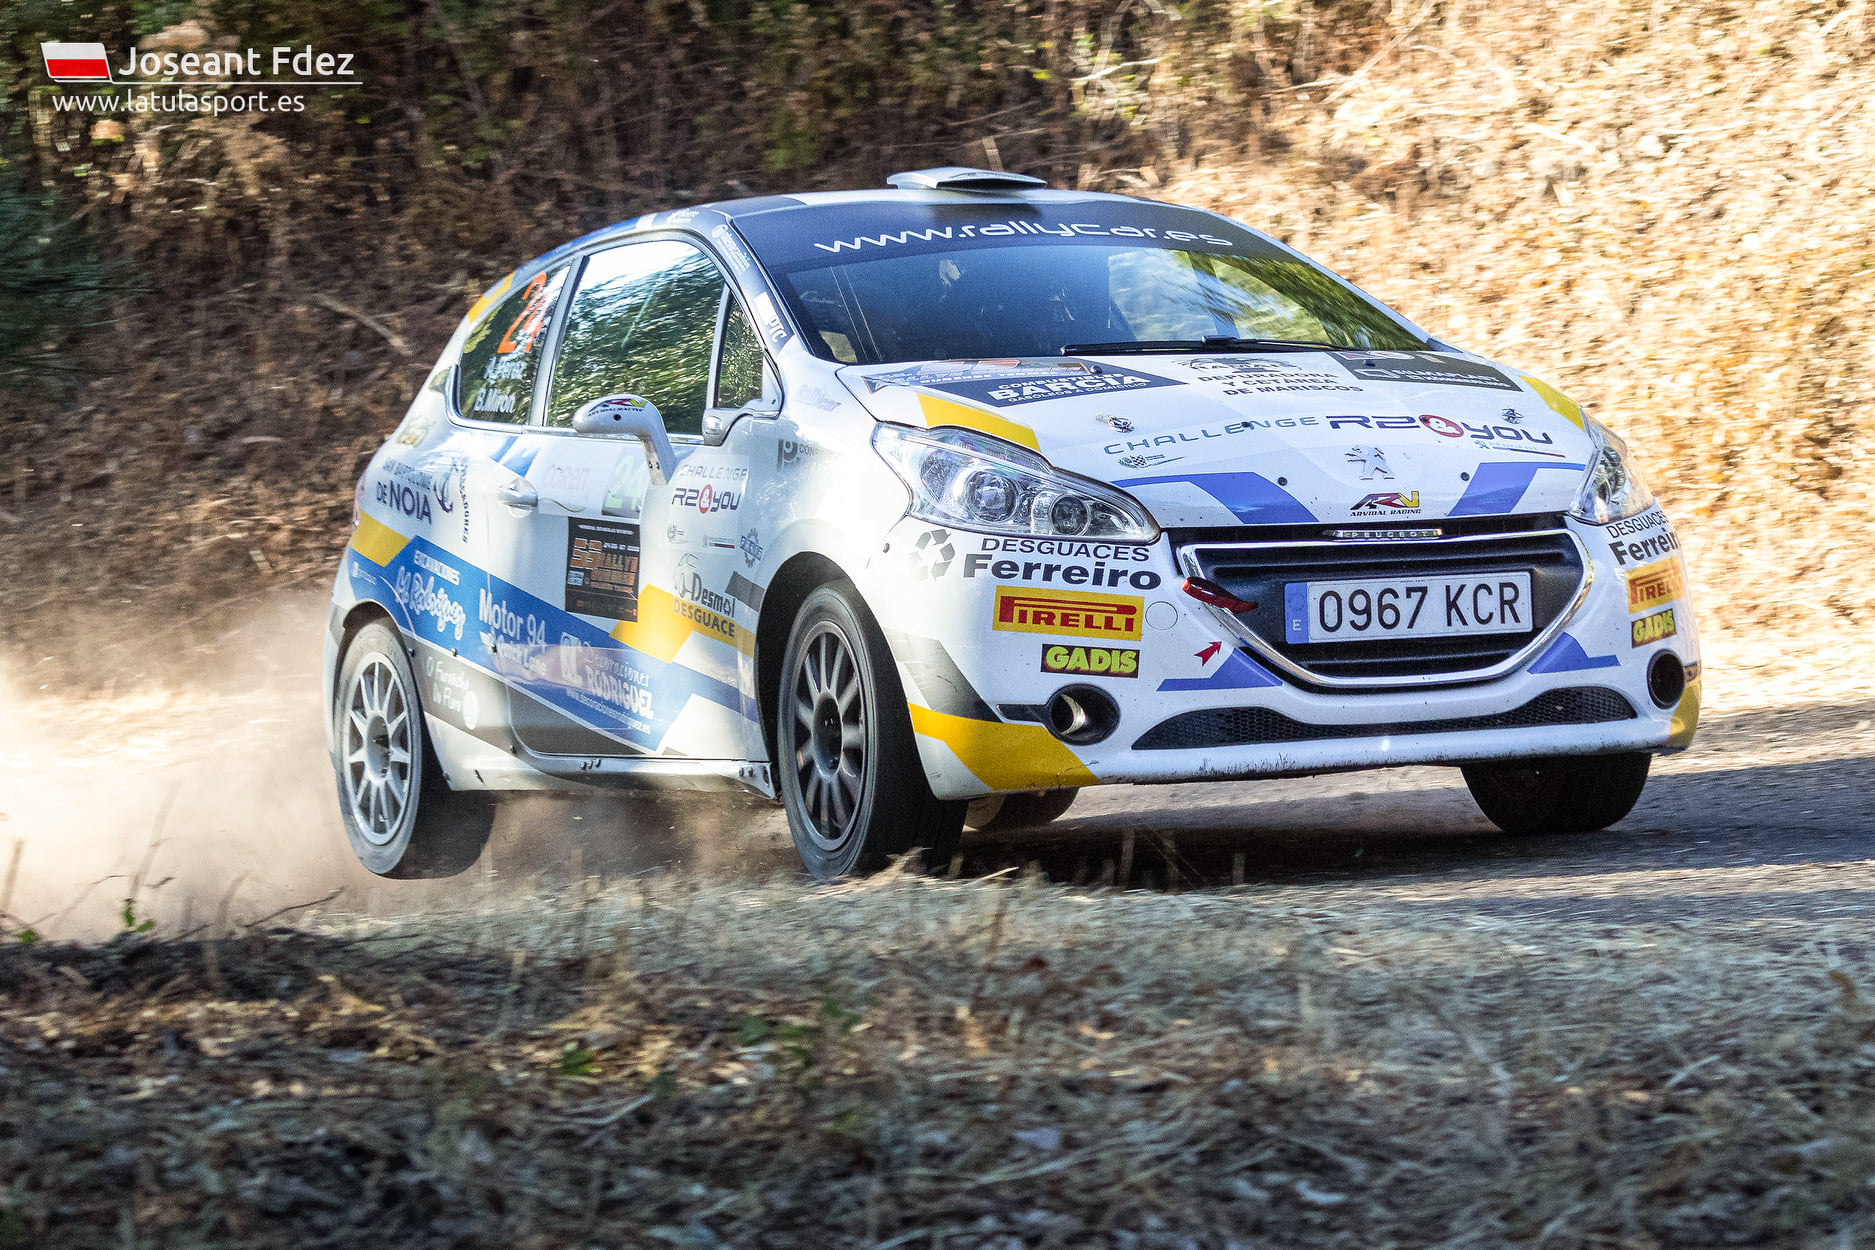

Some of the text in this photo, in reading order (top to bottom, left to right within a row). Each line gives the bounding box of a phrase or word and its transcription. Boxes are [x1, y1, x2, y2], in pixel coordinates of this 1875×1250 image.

[814, 220, 1233, 252] www.rallycar.es
[987, 375, 1152, 401] BARCIA
[1198, 373, 1339, 382] DEPURADORA
[1223, 385, 1365, 396] DE MARISCOS
[1103, 416, 1320, 455] CHALLENGE
[679, 463, 748, 482] CHALLENGE
[376, 479, 432, 525] DE NOIA
[980, 537, 1150, 562] DESGUACES
[1351, 531, 1429, 539] PEUGEOT
[963, 553, 1162, 590] Ferreiro
[479, 588, 524, 641] Motor
[526, 613, 547, 654] 94
[673, 598, 736, 639] DESGUACE
[998, 596, 1137, 633] PIRELLI
[1318, 581, 1521, 633] 0967 KCR
[1292, 619, 1302, 631] E
[1632, 610, 1676, 643] GADIS
[1045, 646, 1137, 674] GADIS
[585, 664, 655, 720] RODRIGUEZ
